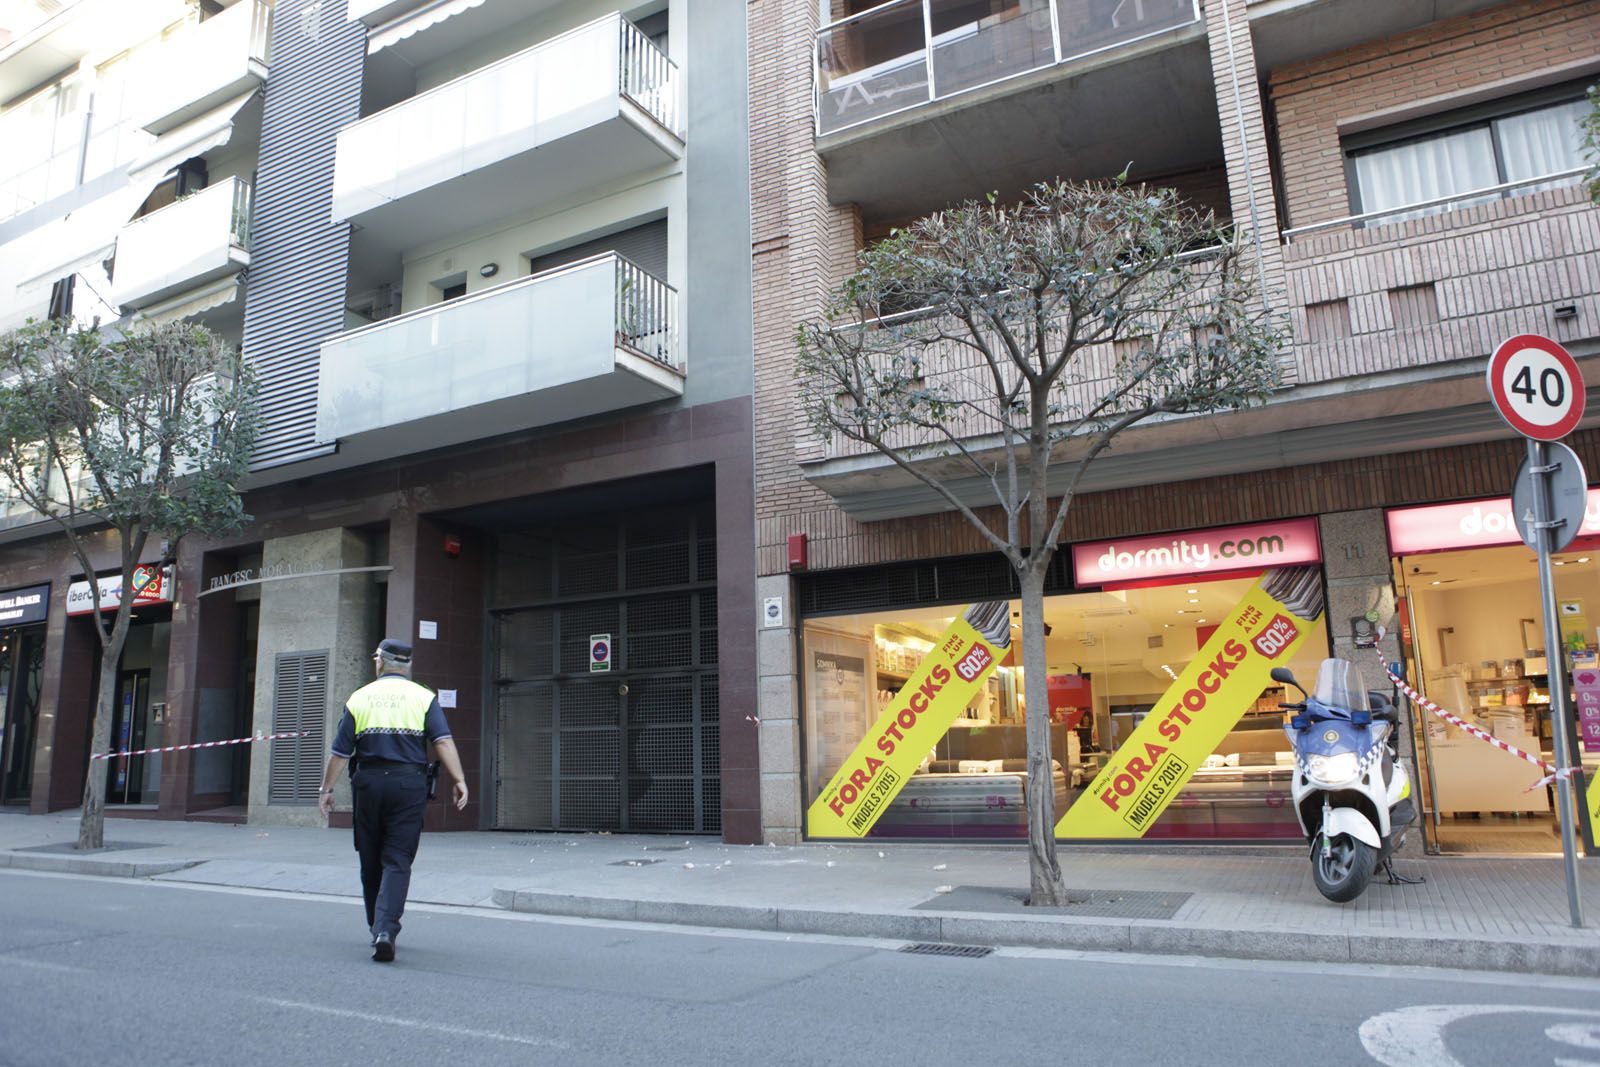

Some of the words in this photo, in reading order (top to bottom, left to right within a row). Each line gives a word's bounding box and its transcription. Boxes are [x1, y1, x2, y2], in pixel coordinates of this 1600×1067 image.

[1511, 366, 1565, 407] 40
[1098, 535, 1284, 571] dormity.com
[69, 585, 107, 602] iberCja
[1236, 604, 1256, 626] FINS
[1250, 610, 1264, 625] UN
[942, 633, 959, 653] FINS
[953, 639, 965, 652] UN
[1256, 618, 1289, 655] 60%
[958, 646, 985, 679] 60%
[828, 756, 885, 818] FORA
[877, 664, 951, 756] STOCKS
[1100, 742, 1169, 812] FORA
[1158, 638, 1248, 742] STOCKS
[852, 793, 881, 830] MODELS
[876, 771, 895, 796] 2015
[1129, 783, 1165, 825] MODELS
[1158, 760, 1182, 787] 2015
